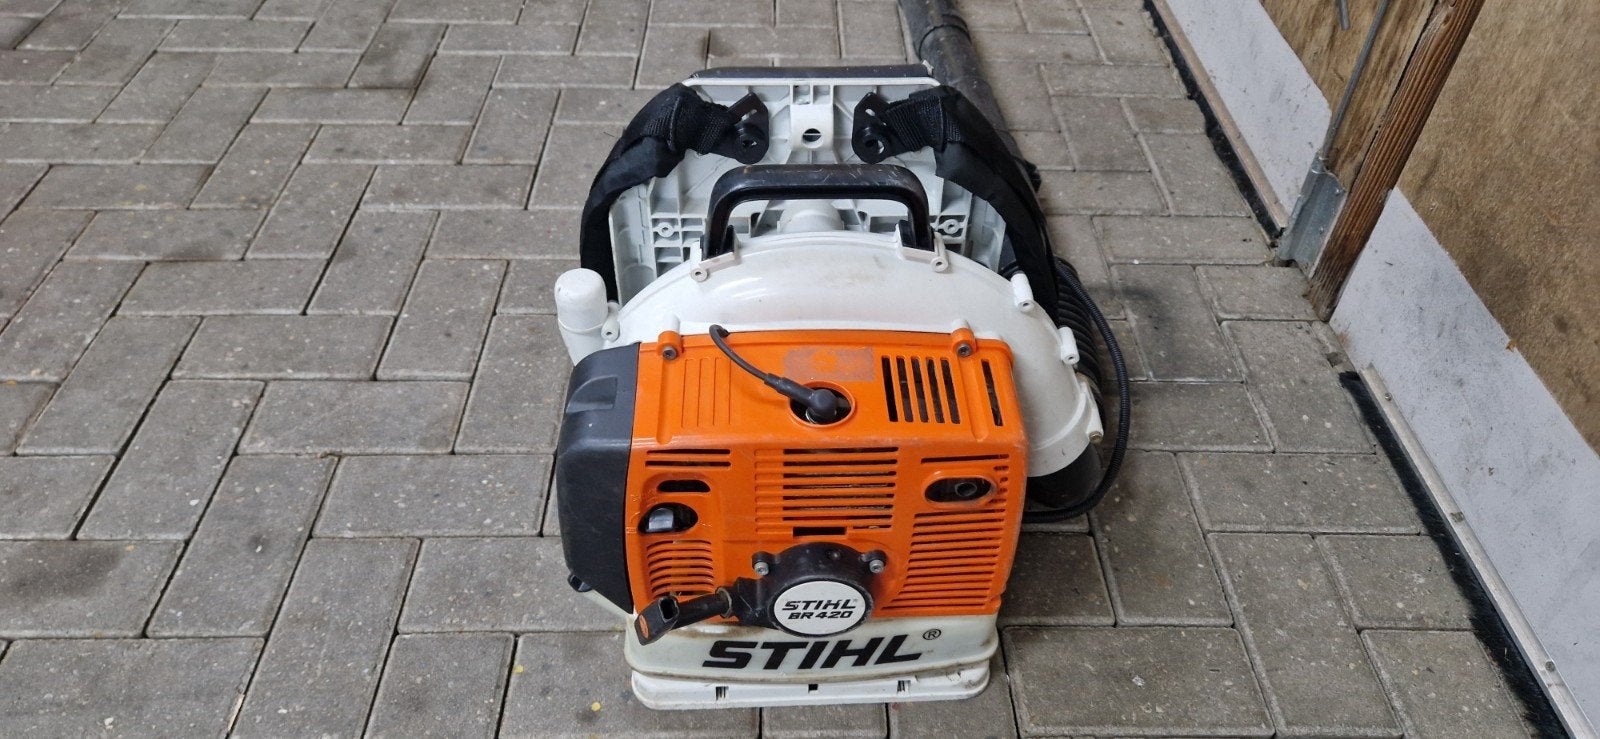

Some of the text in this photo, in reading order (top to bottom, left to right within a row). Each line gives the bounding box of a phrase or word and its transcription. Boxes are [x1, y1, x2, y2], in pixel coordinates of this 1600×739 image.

[782, 599, 856, 611] STIHL
[788, 611, 854, 620] BR 420
[702, 634, 922, 670] STIHL
